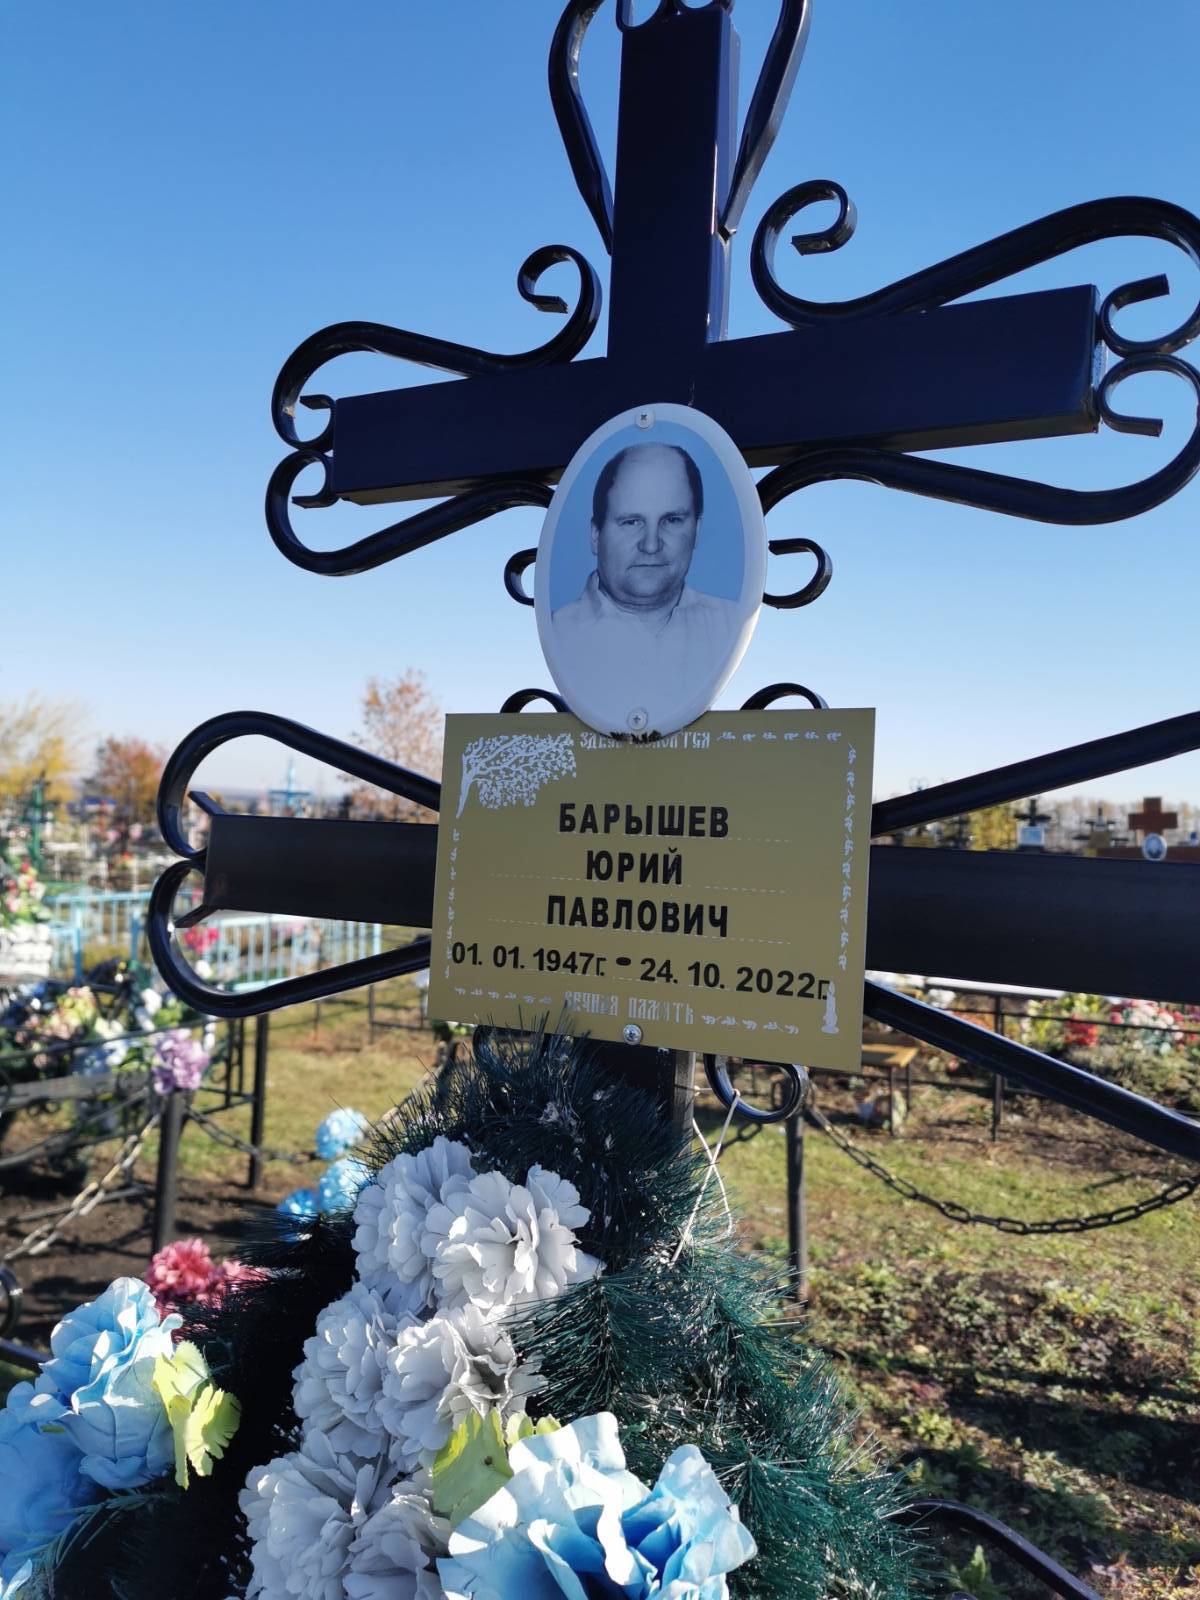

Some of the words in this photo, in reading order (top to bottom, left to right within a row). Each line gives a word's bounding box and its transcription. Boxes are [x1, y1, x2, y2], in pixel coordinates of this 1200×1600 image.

[559, 802, 729, 838] БАРЫШЕВ
[586, 846, 683, 886] ЮРИЙ
[547, 895, 728, 938] ПАВЛОВИЧ
